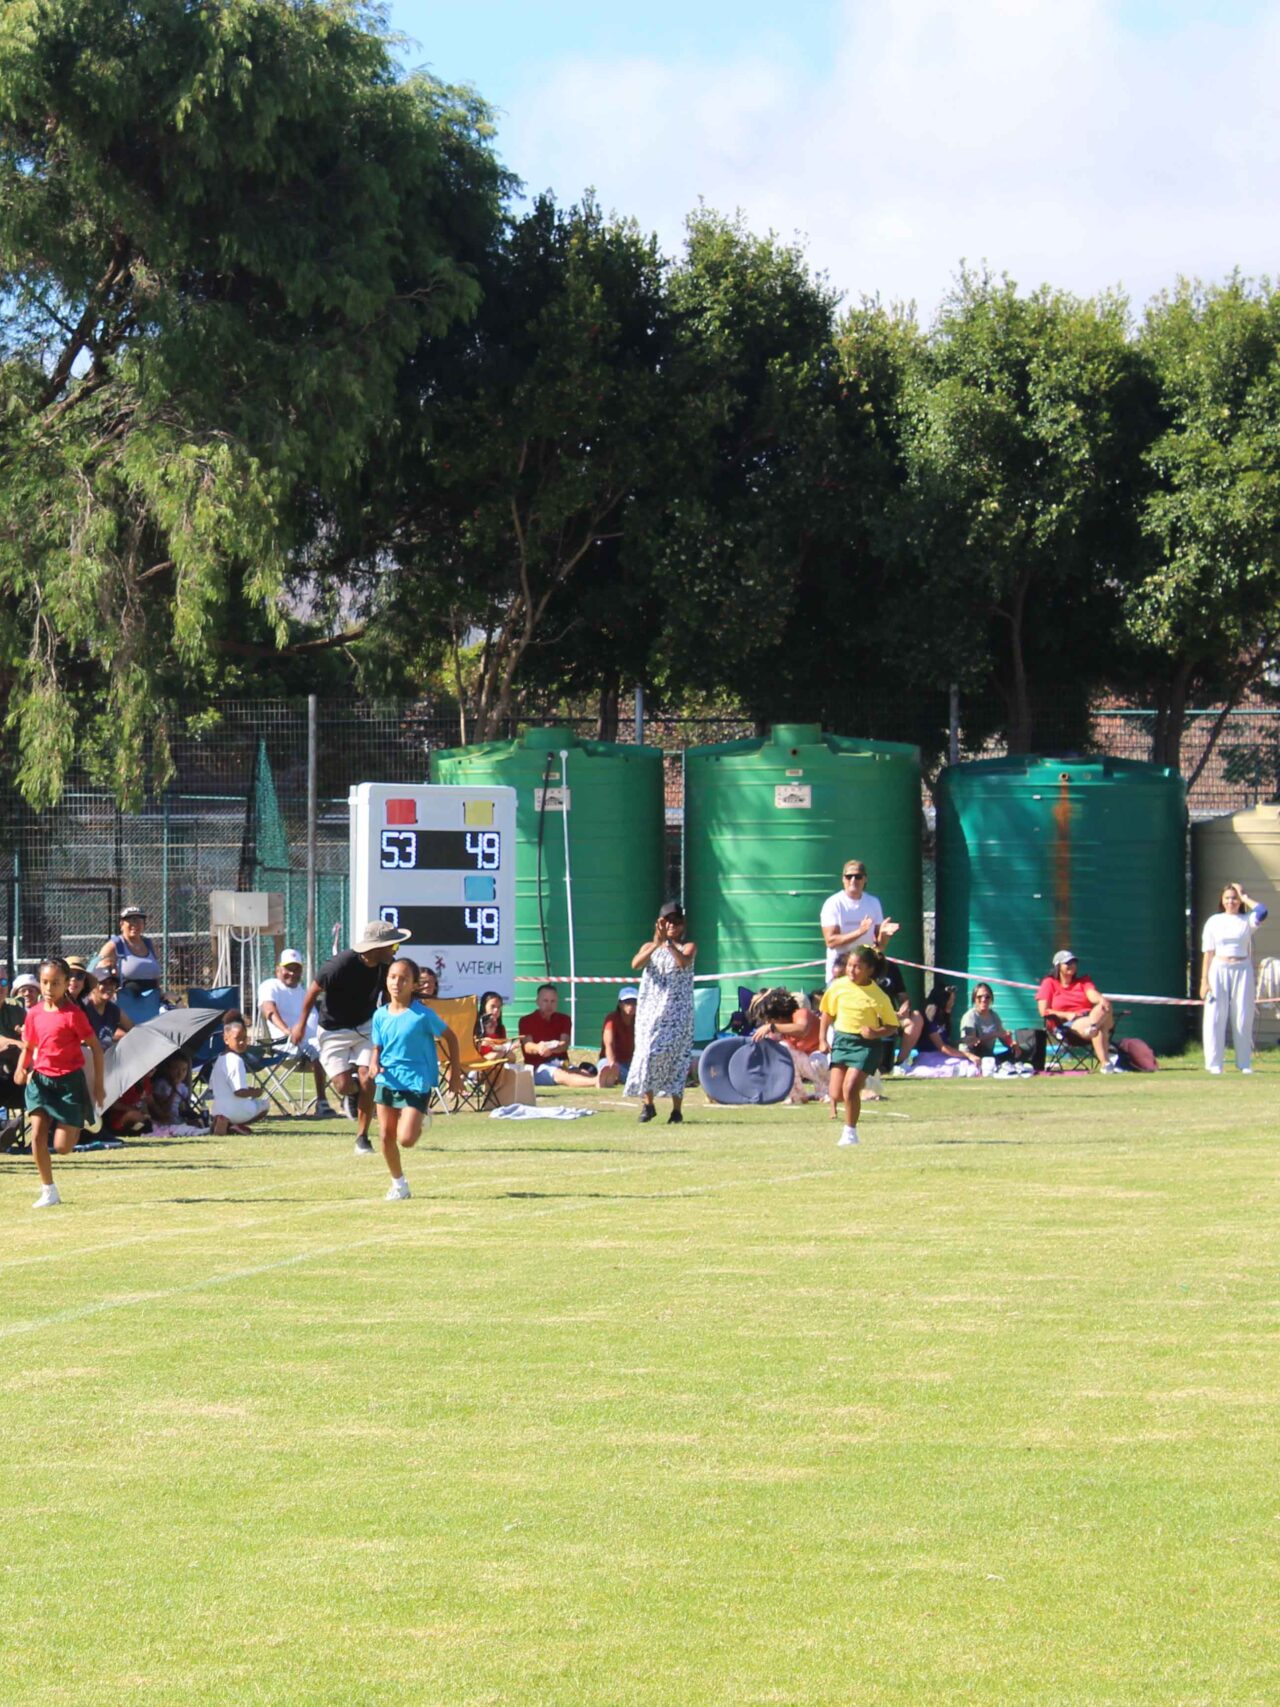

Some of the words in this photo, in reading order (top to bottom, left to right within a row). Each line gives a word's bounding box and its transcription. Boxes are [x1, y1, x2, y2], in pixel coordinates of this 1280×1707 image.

[381, 831, 417, 868] 53
[465, 832, 500, 869] 49
[464, 907, 499, 944] 49
